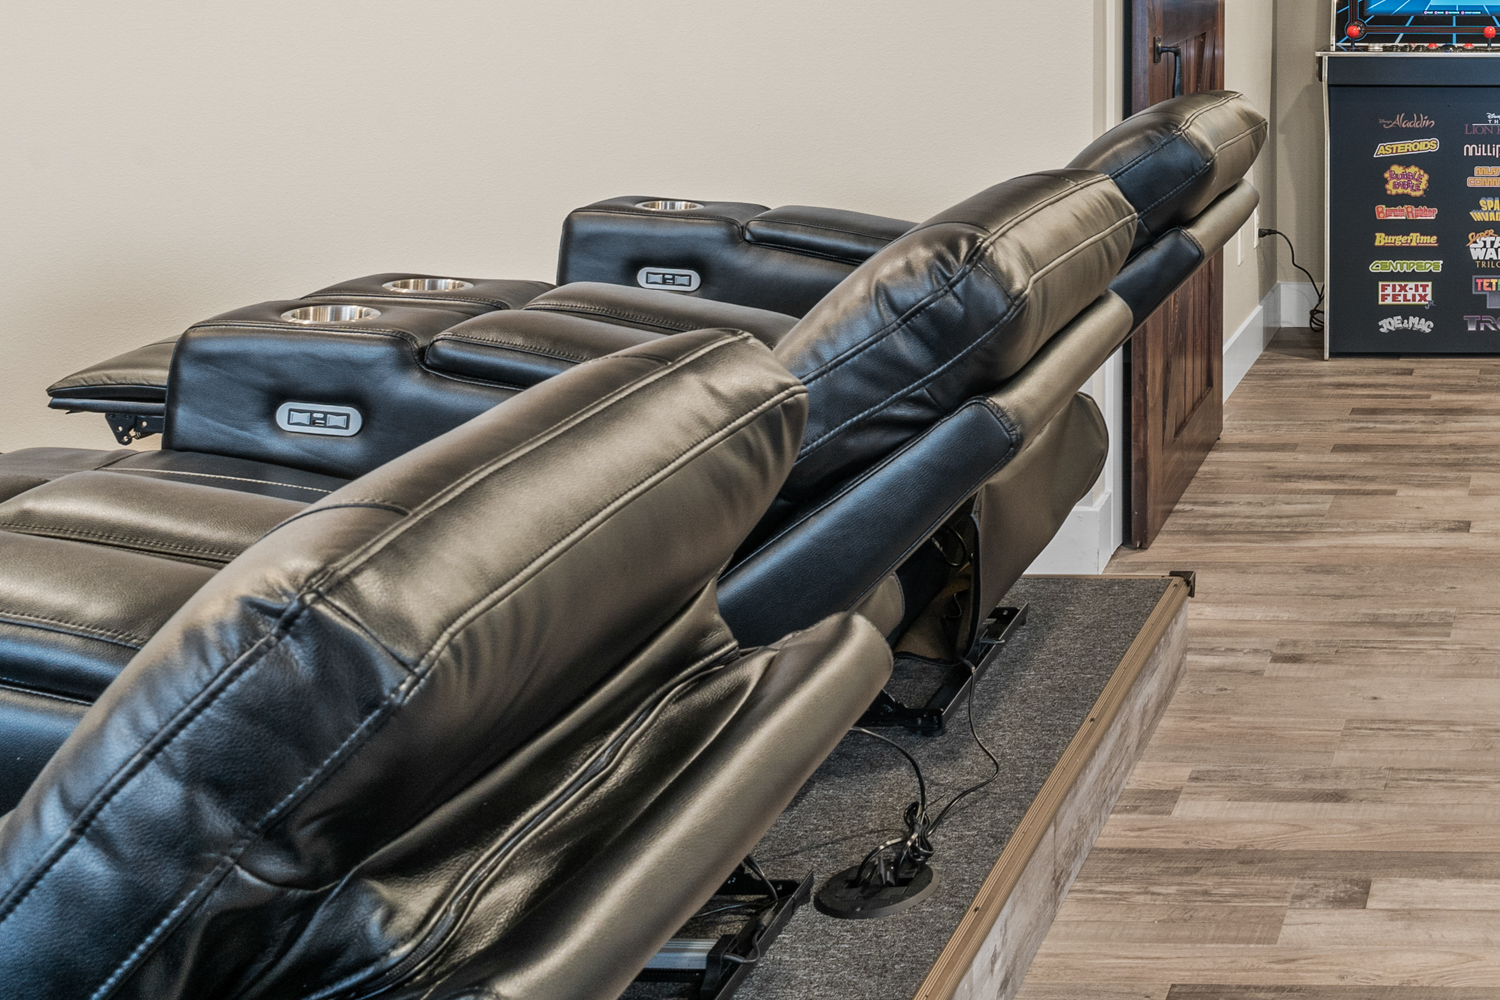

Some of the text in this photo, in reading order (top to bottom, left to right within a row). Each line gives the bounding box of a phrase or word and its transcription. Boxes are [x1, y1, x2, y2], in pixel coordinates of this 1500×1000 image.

[1383, 112, 1435, 129] Aladdin
[1464, 124, 1494, 135] LION
[1376, 139, 1438, 156] ASTEROIDS
[1388, 169, 1424, 184] BUBBLE
[1368, 260, 1443, 273] CENTIPEDE
[1381, 283, 1430, 293] FIX-IT
[1381, 293, 1429, 303] FELIX
[1378, 315, 1403, 333] JOE
[1408, 315, 1434, 334] MAC
